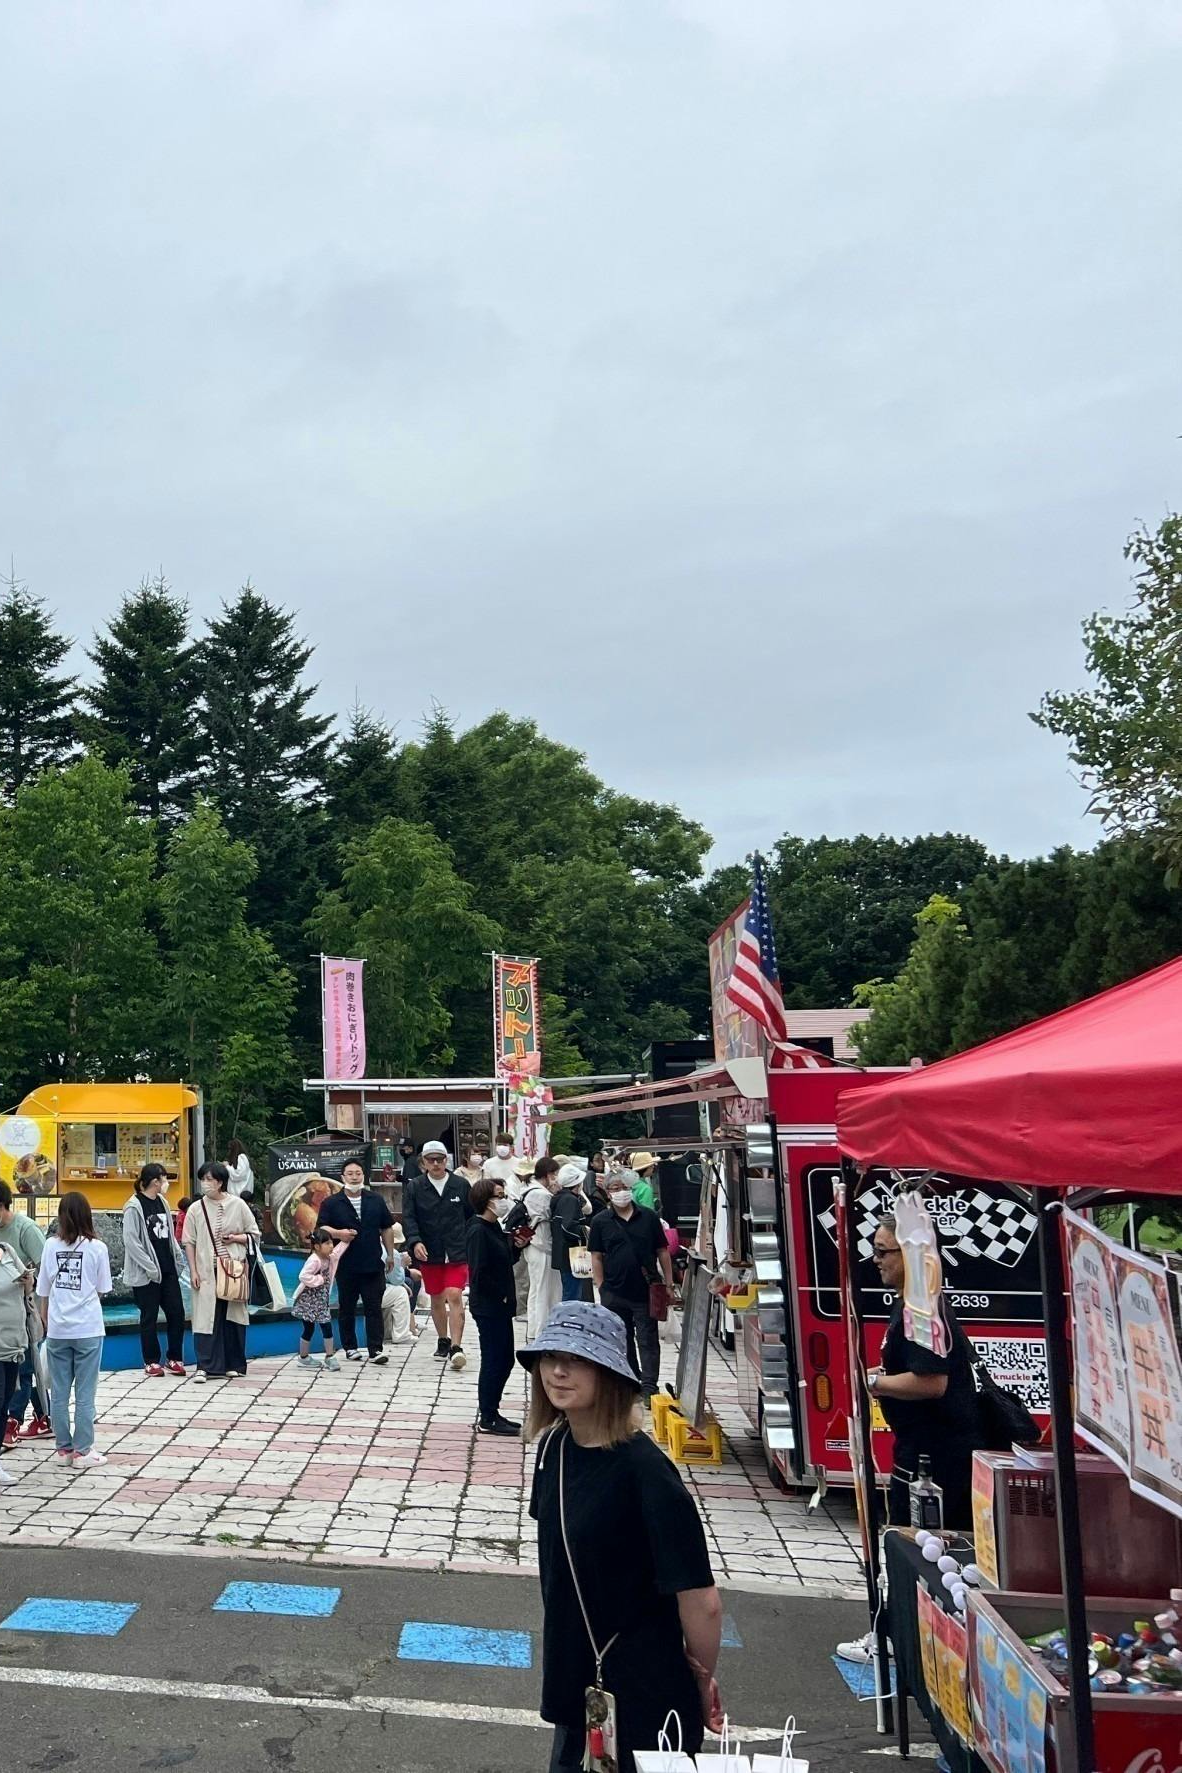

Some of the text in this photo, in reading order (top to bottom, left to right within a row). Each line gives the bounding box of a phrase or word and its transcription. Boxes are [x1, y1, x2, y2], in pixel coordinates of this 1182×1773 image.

[502, 961, 531, 1059] ブリトー
[345, 971, 360, 1074] 肉巻きおにぎりドッグ
[278, 1161, 317, 1170] USAMIN
[882, 1195, 967, 1213] kckle
[993, 1372, 1031, 1381] knuckle
